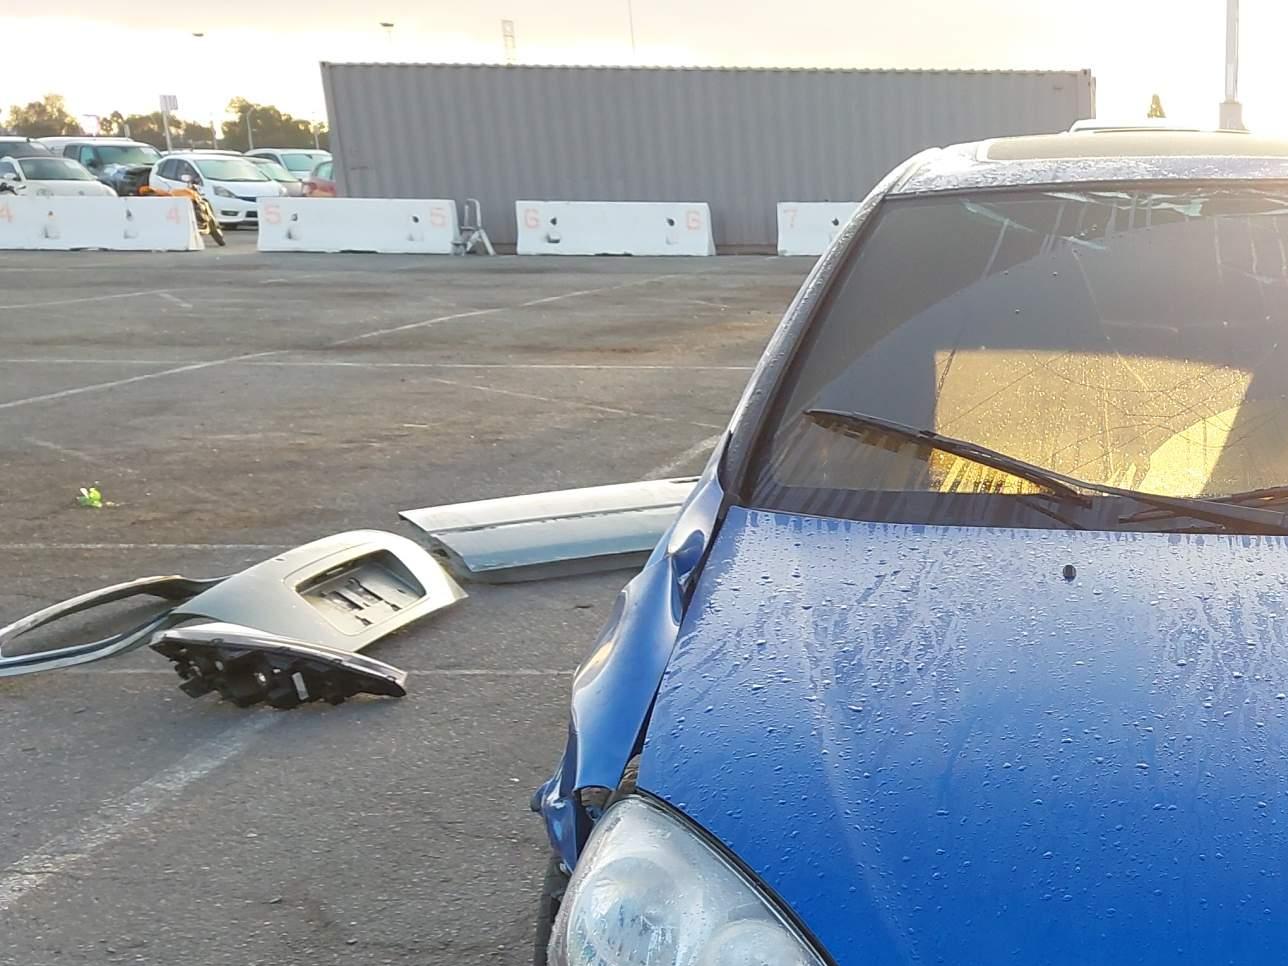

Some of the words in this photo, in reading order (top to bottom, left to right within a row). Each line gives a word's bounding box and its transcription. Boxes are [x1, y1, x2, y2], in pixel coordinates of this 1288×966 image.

[166, 205, 180, 224] 4
[264, 204, 281, 224] 5
[431, 207, 446, 227] 5
[524, 209, 539, 229] 6
[686, 210, 701, 230] 6
